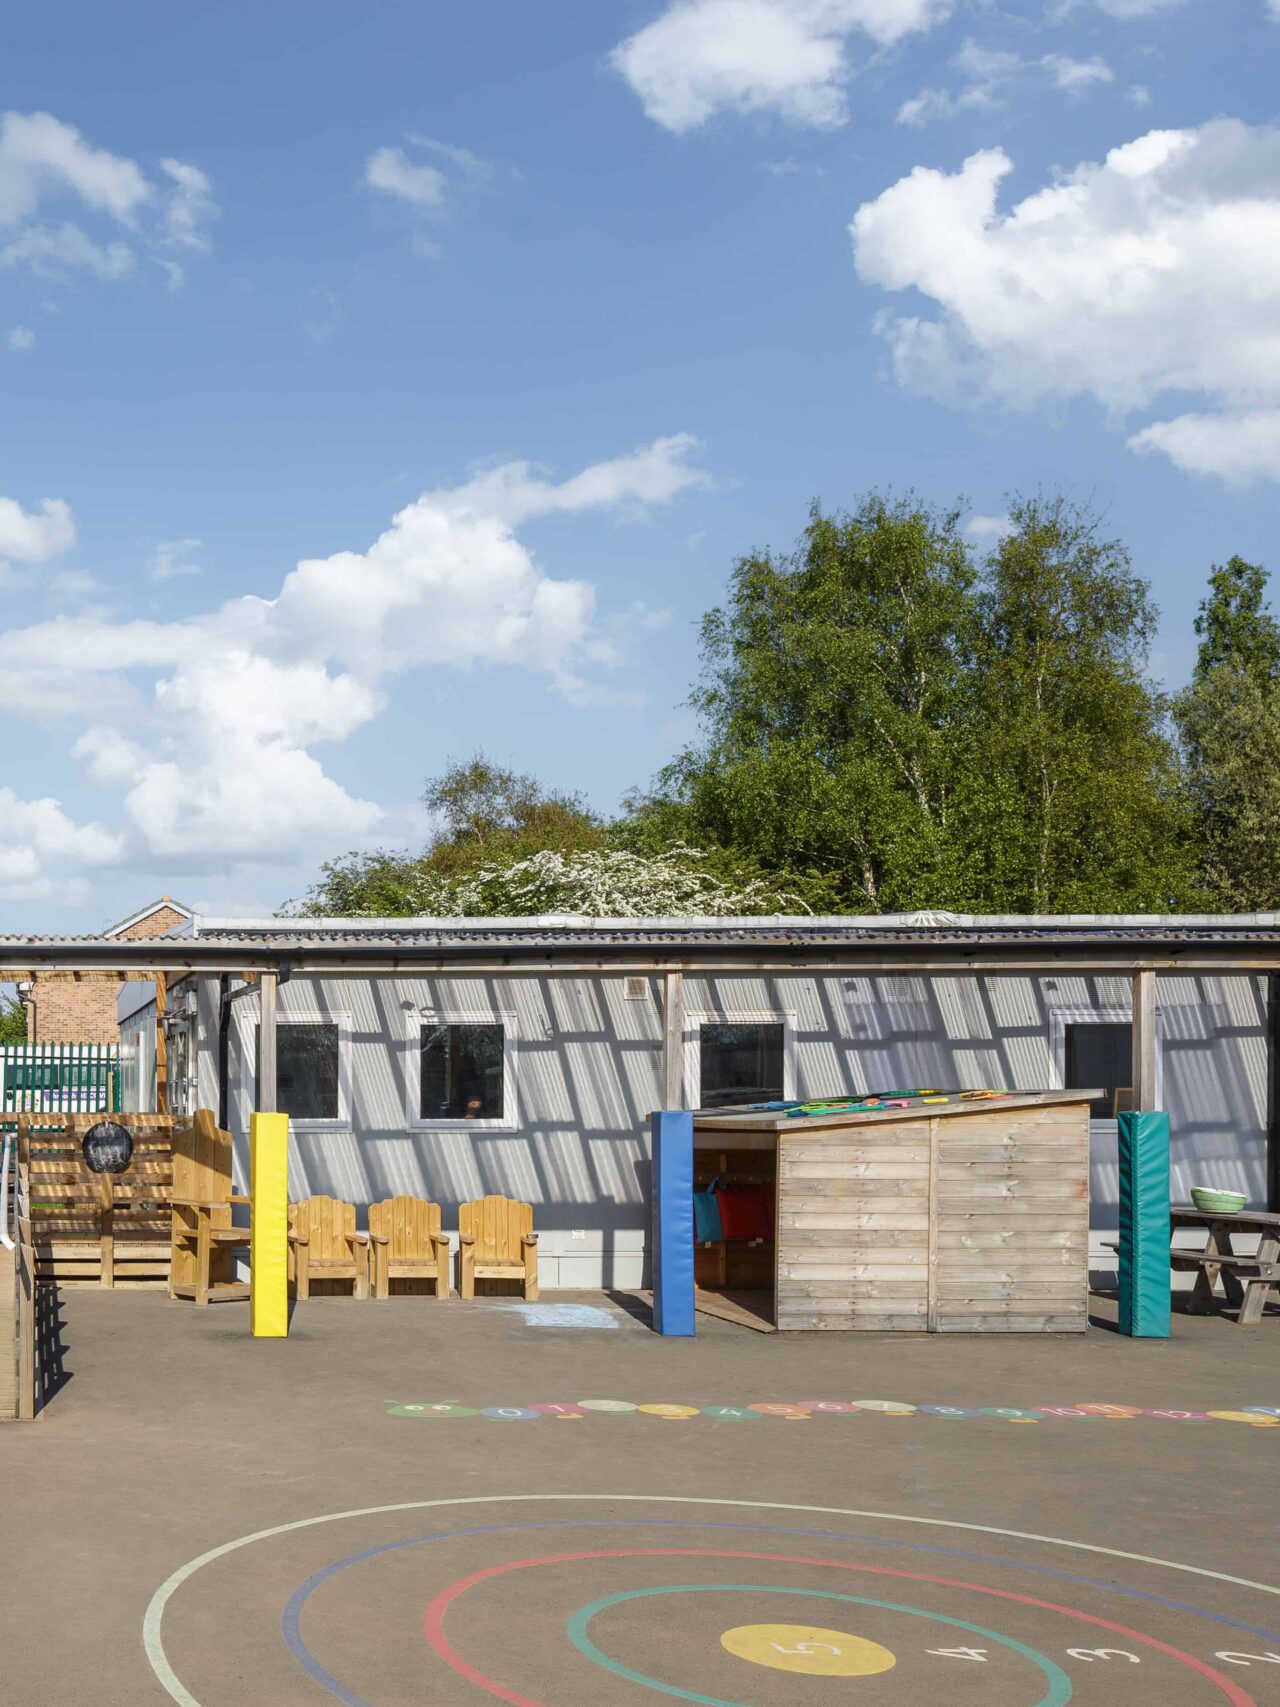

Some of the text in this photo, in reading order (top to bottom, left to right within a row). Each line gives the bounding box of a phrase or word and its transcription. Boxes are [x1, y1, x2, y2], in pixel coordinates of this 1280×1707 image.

[497, 1408, 522, 1417] 0
[547, 1404, 565, 1412] 1
[719, 1408, 742, 1416] 4
[767, 1405, 793, 1413] 5
[818, 1402, 842, 1410] 6
[935, 1406, 964, 1415] 8
[996, 1408, 1023, 1417] 9
[1040, 1407, 1086, 1416] 10
[1088, 1404, 1127, 1413] 11
[1153, 1410, 1204, 1419] 12
[770, 1641, 1280, 1665] 5 4 3 2
